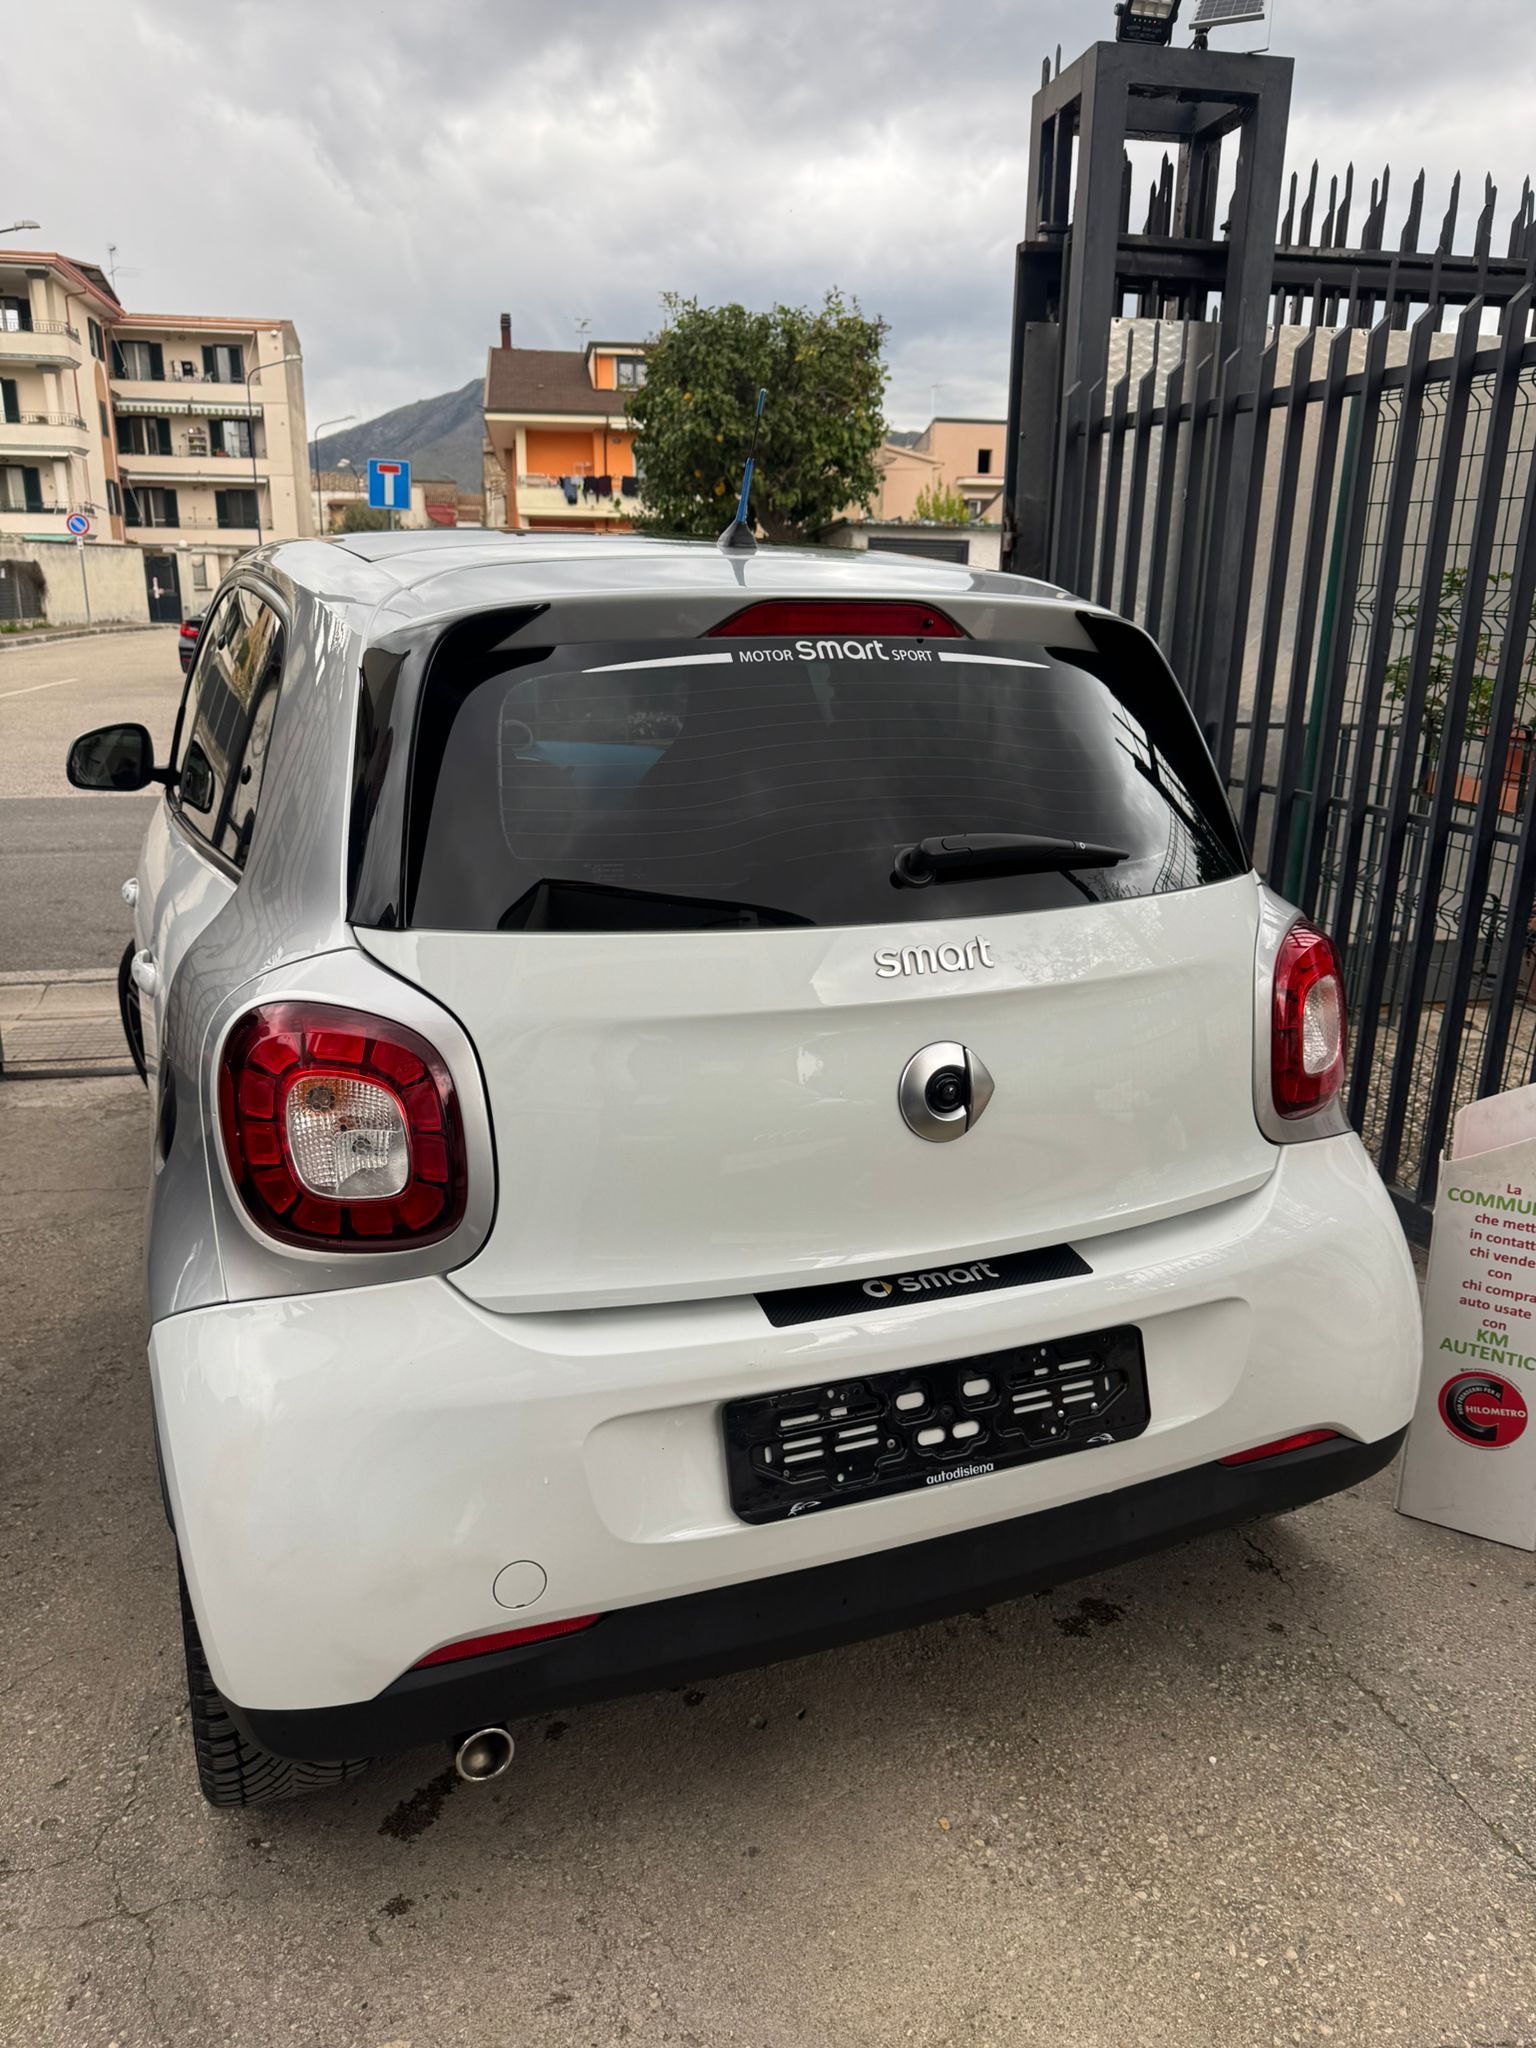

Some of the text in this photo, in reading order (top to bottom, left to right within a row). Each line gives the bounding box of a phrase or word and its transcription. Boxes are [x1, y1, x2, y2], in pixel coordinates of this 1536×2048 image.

[739, 640, 933, 663] MOTOR smart SPORT
[874, 934, 995, 979] smart
[1506, 1183, 1522, 1196] La
[1447, 1187, 1536, 1216] COMMU
[1474, 1213, 1499, 1226] che
[1469, 1228, 1482, 1240] in
[1469, 1246, 1536, 1268] chi vende
[898, 1261, 1000, 1293] smart
[1487, 1268, 1512, 1281] con
[1462, 1279, 1536, 1303] chi compra
[1459, 1296, 1532, 1319] auto usate
[1482, 1318, 1507, 1331] con
[1476, 1328, 1509, 1348] KM
[1439, 1337, 1536, 1371] AUTENTIC
[926, 1462, 994, 1485] autodisiena
